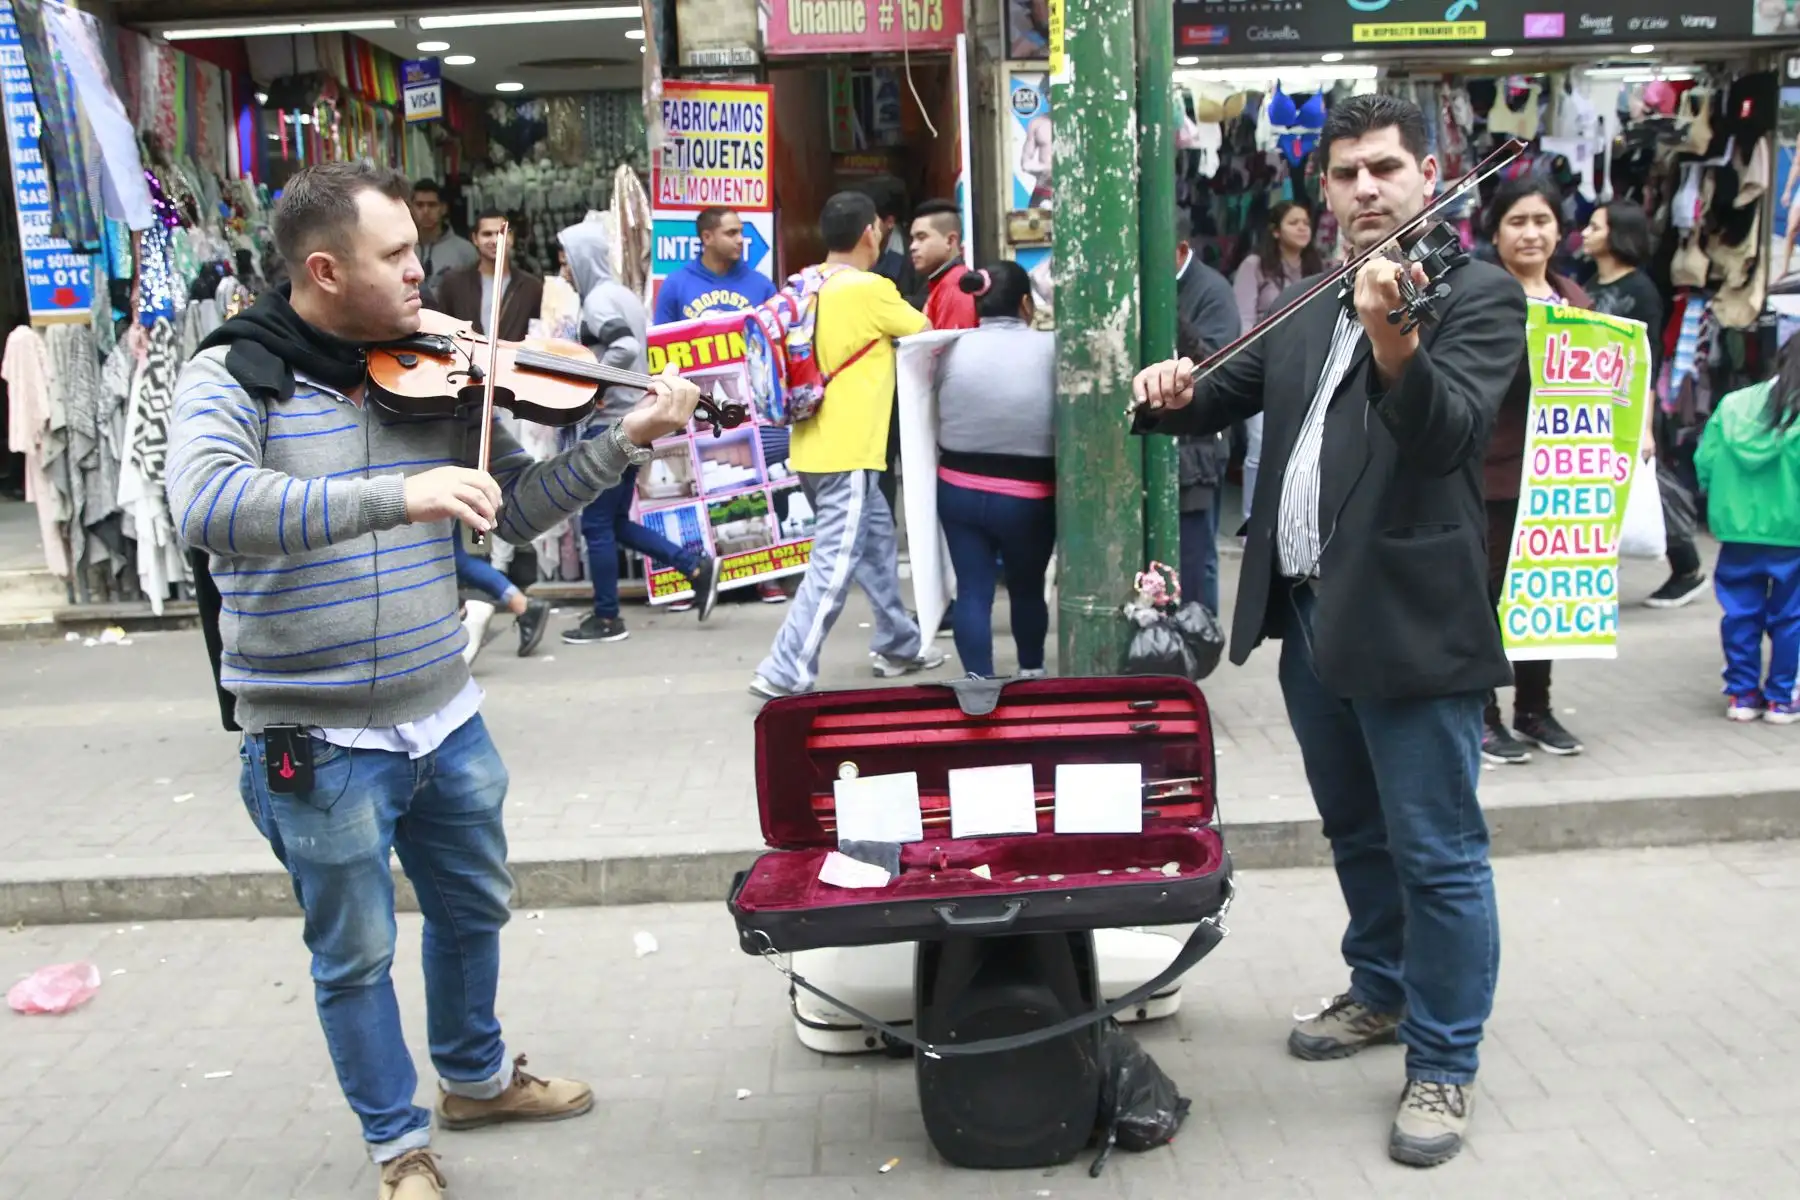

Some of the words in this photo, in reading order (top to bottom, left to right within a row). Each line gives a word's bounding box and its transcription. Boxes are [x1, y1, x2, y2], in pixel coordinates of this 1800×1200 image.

[411, 92, 437, 109] VISA
[663, 100, 763, 133] FABRICAMOS
[663, 138, 764, 170] ETIQUETAS
[663, 177, 681, 200] AL
[687, 177, 764, 202] MOMENTO
[657, 236, 752, 262] INTET
[1545, 333, 1634, 393] lizch
[1533, 407, 1612, 435] ABAN
[1524, 487, 1612, 515] DRED
[1517, 528, 1615, 556] TOALL
[1510, 568, 1615, 599] FORRO
[1508, 604, 1619, 636] COLCH
